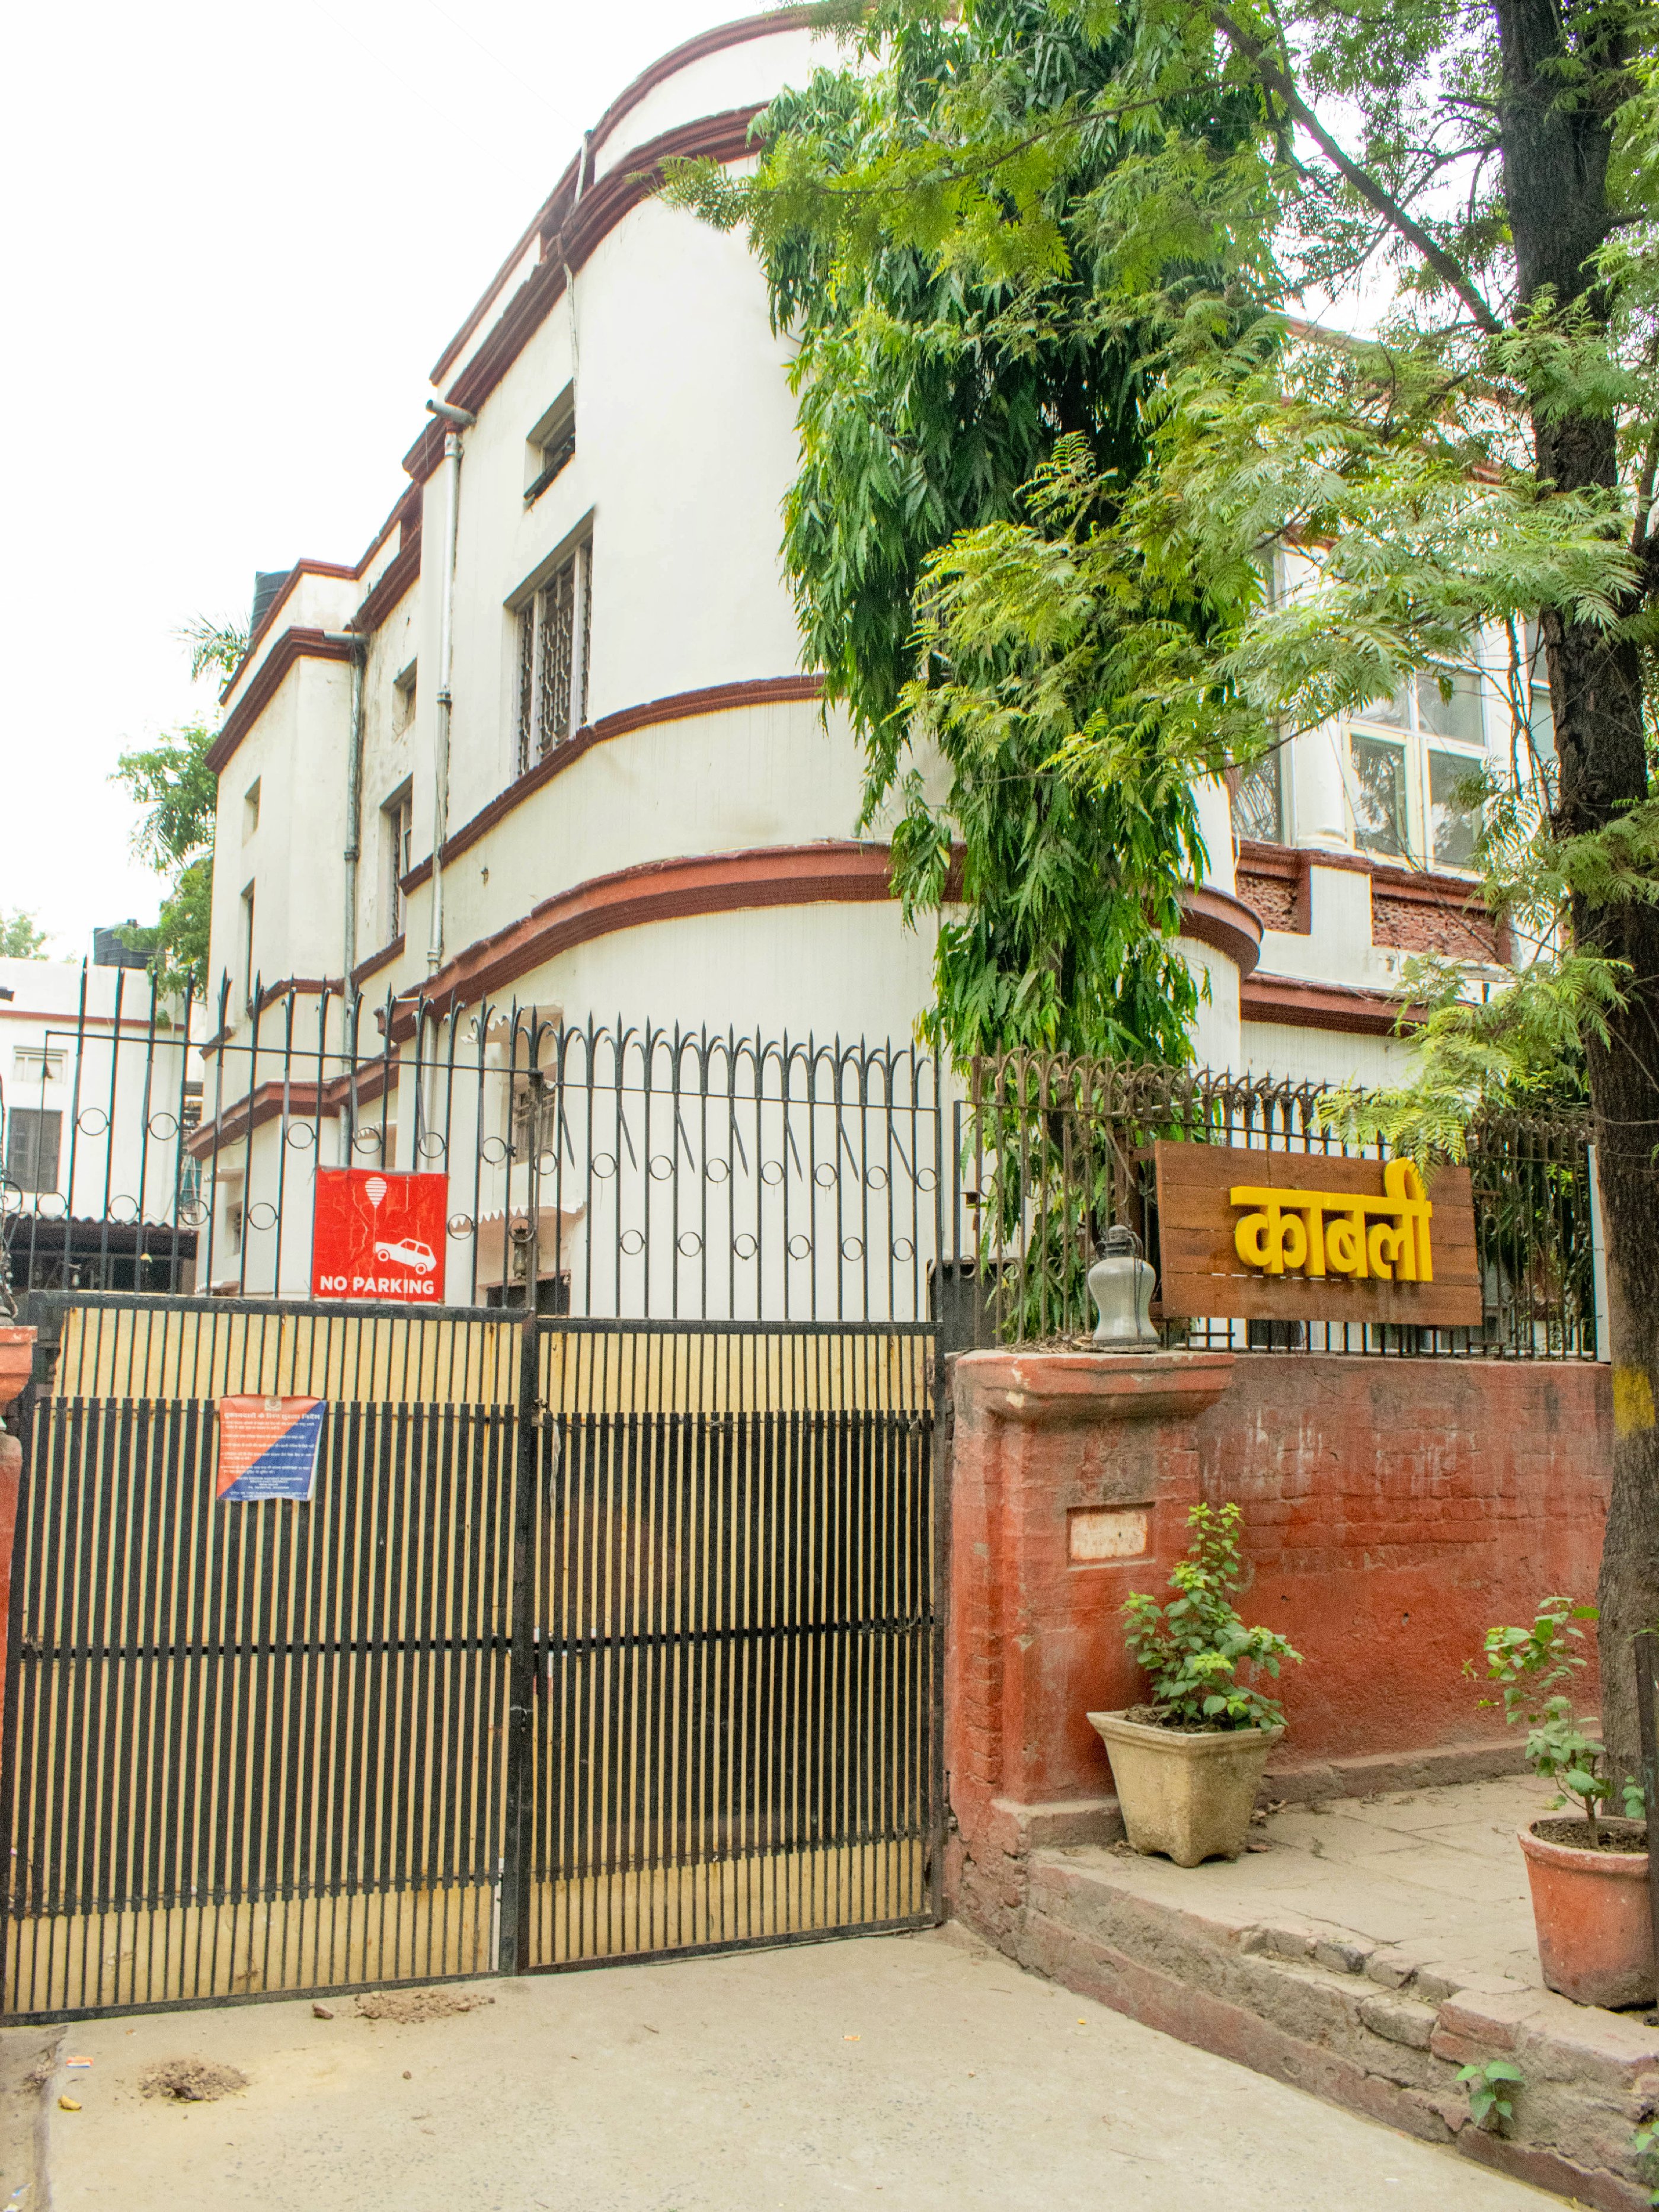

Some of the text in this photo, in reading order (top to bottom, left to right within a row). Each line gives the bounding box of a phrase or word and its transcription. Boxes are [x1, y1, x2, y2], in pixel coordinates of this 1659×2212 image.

[1230, 1157, 1433, 1282] काबली
[320, 1276, 434, 1295] NO PARKING
